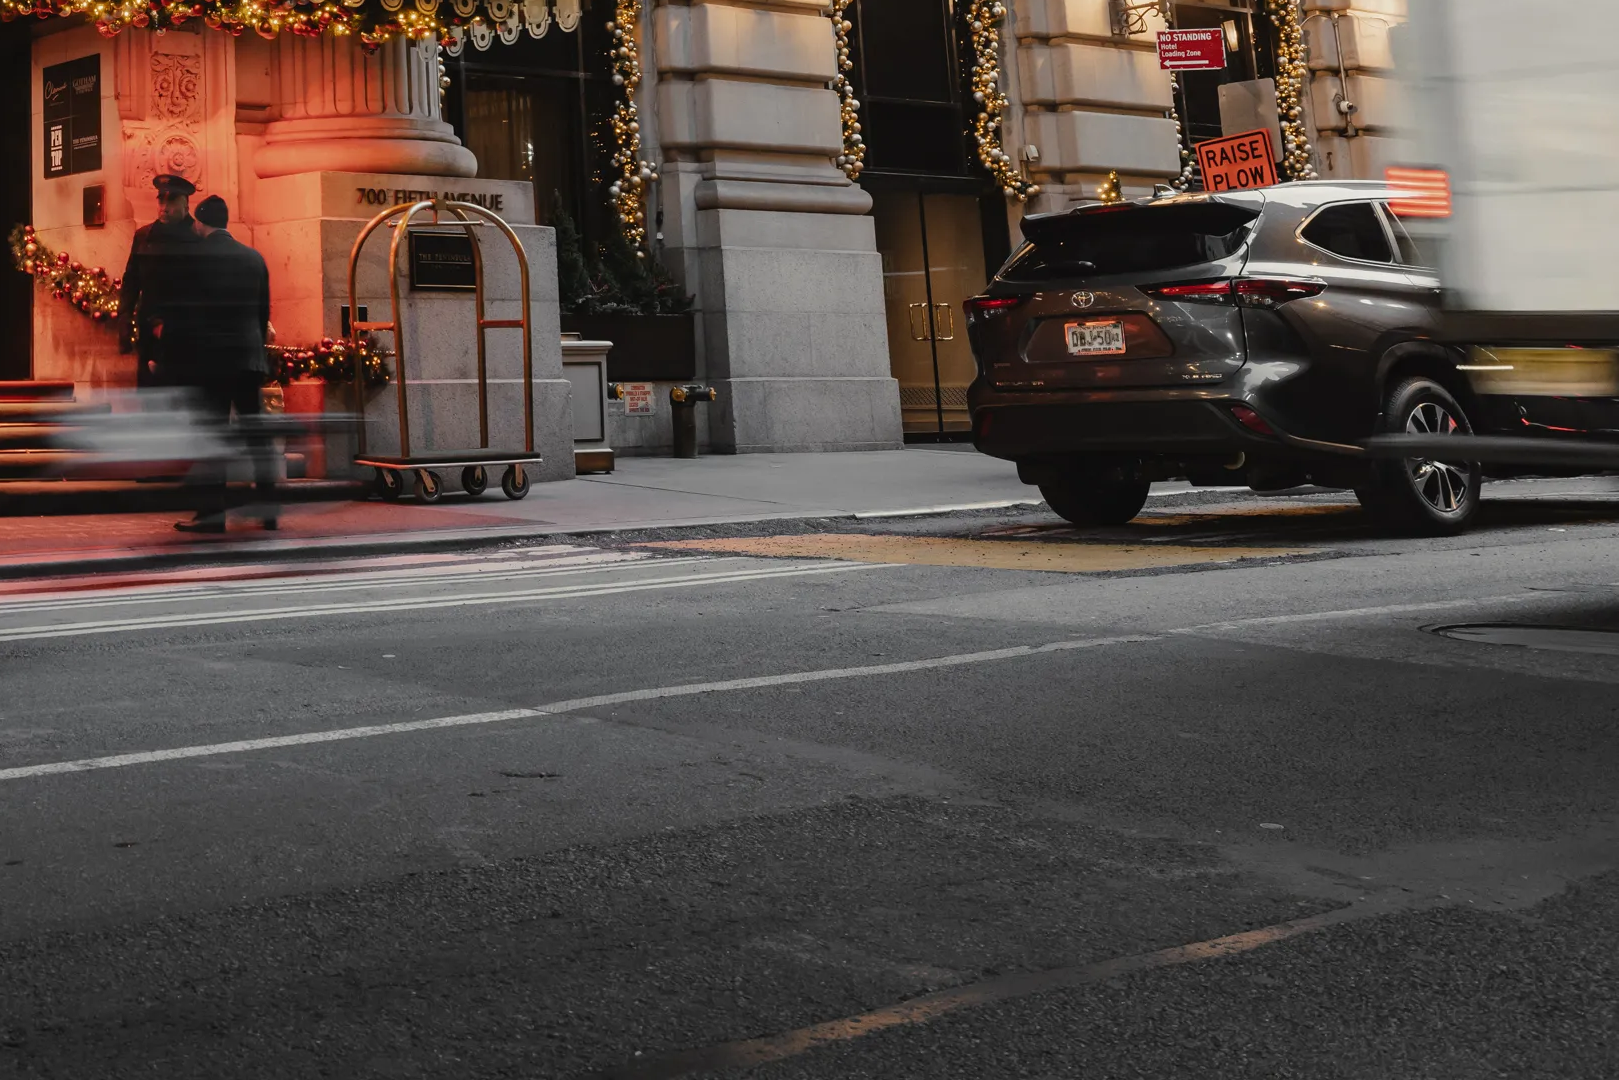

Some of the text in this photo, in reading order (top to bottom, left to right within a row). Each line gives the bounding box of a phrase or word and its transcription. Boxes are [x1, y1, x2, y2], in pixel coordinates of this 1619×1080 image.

[1159, 32, 1212, 42] NO STANDING
[1161, 49, 1202, 58] Loading Zone
[50, 129, 63, 147] PEN
[50, 150, 63, 167] TOP
[1204, 139, 1263, 169] RAISE
[1212, 165, 1265, 191] PLOW
[355, 187, 386, 205] 700
